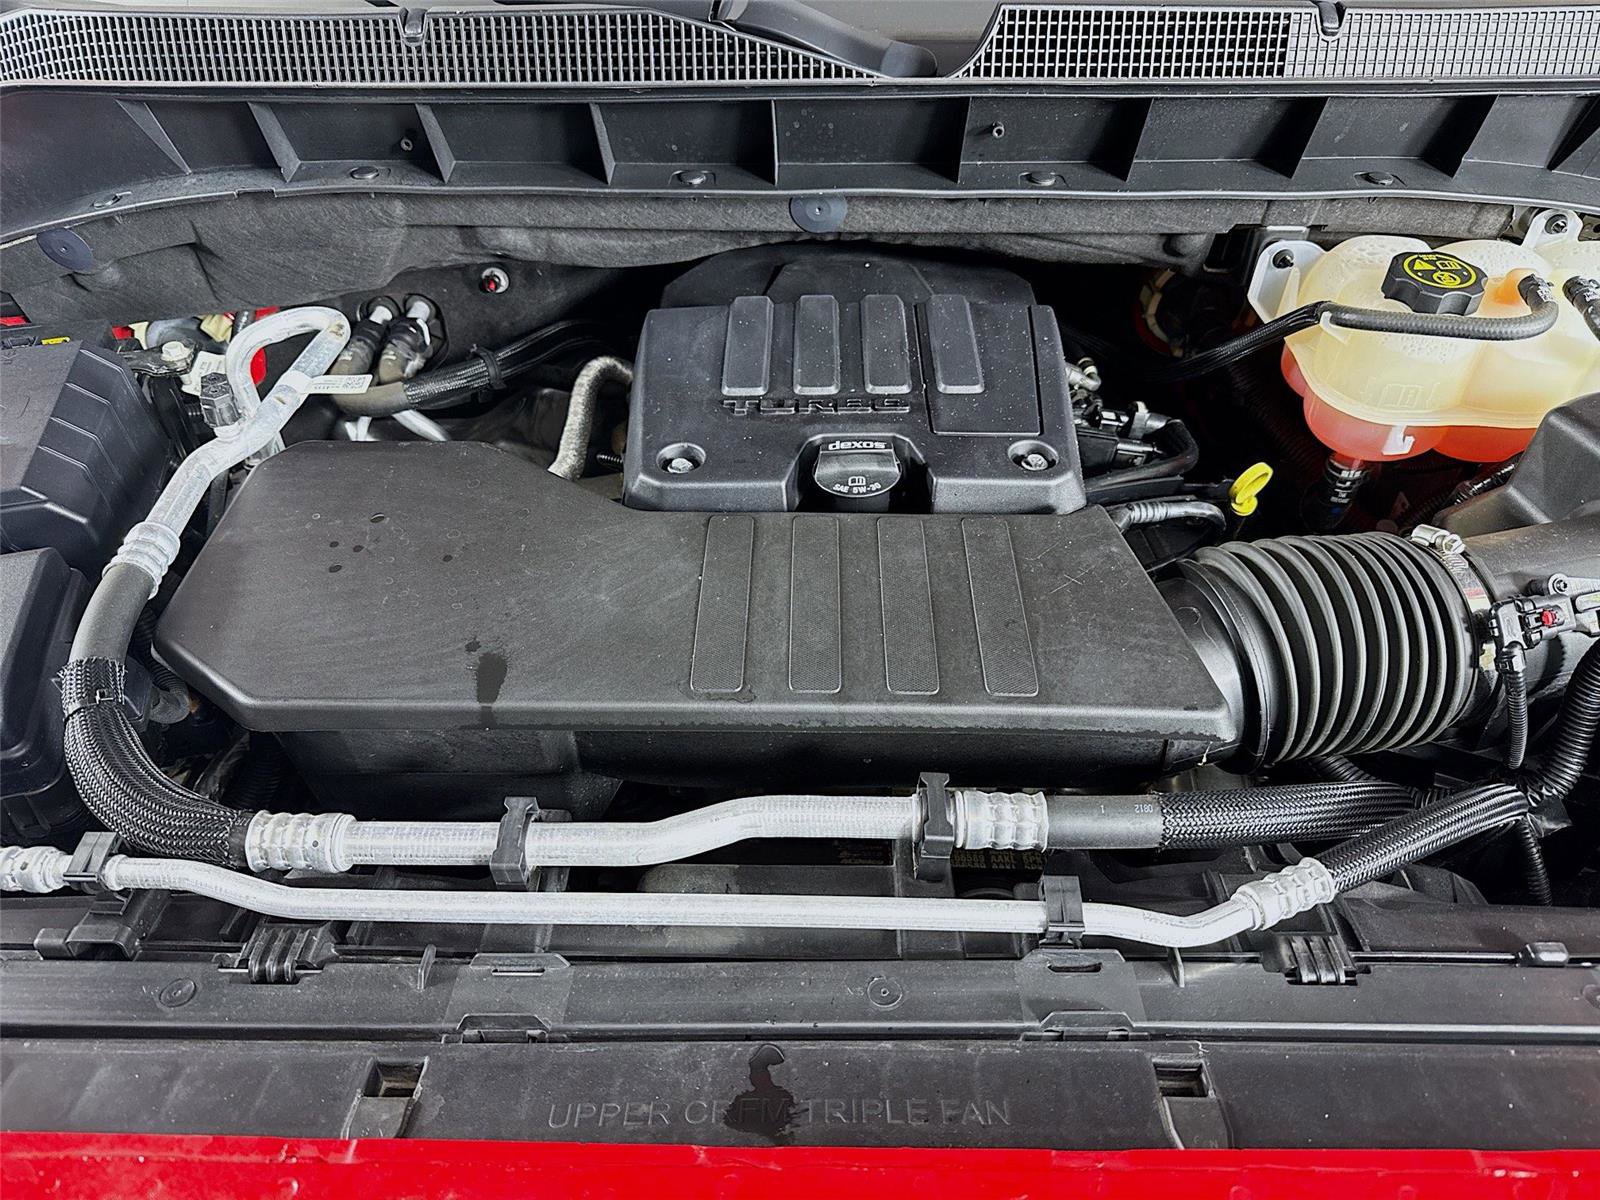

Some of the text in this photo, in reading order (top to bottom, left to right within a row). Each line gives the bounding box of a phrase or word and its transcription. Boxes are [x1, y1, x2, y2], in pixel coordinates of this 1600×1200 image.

[828, 440, 887, 451] dexos
[833, 482, 882, 494] SAE 5W-30
[548, 1102, 671, 1129] UPPER
[800, 1099, 930, 1125] TRIPLE
[940, 1099, 1011, 1126] FAN
